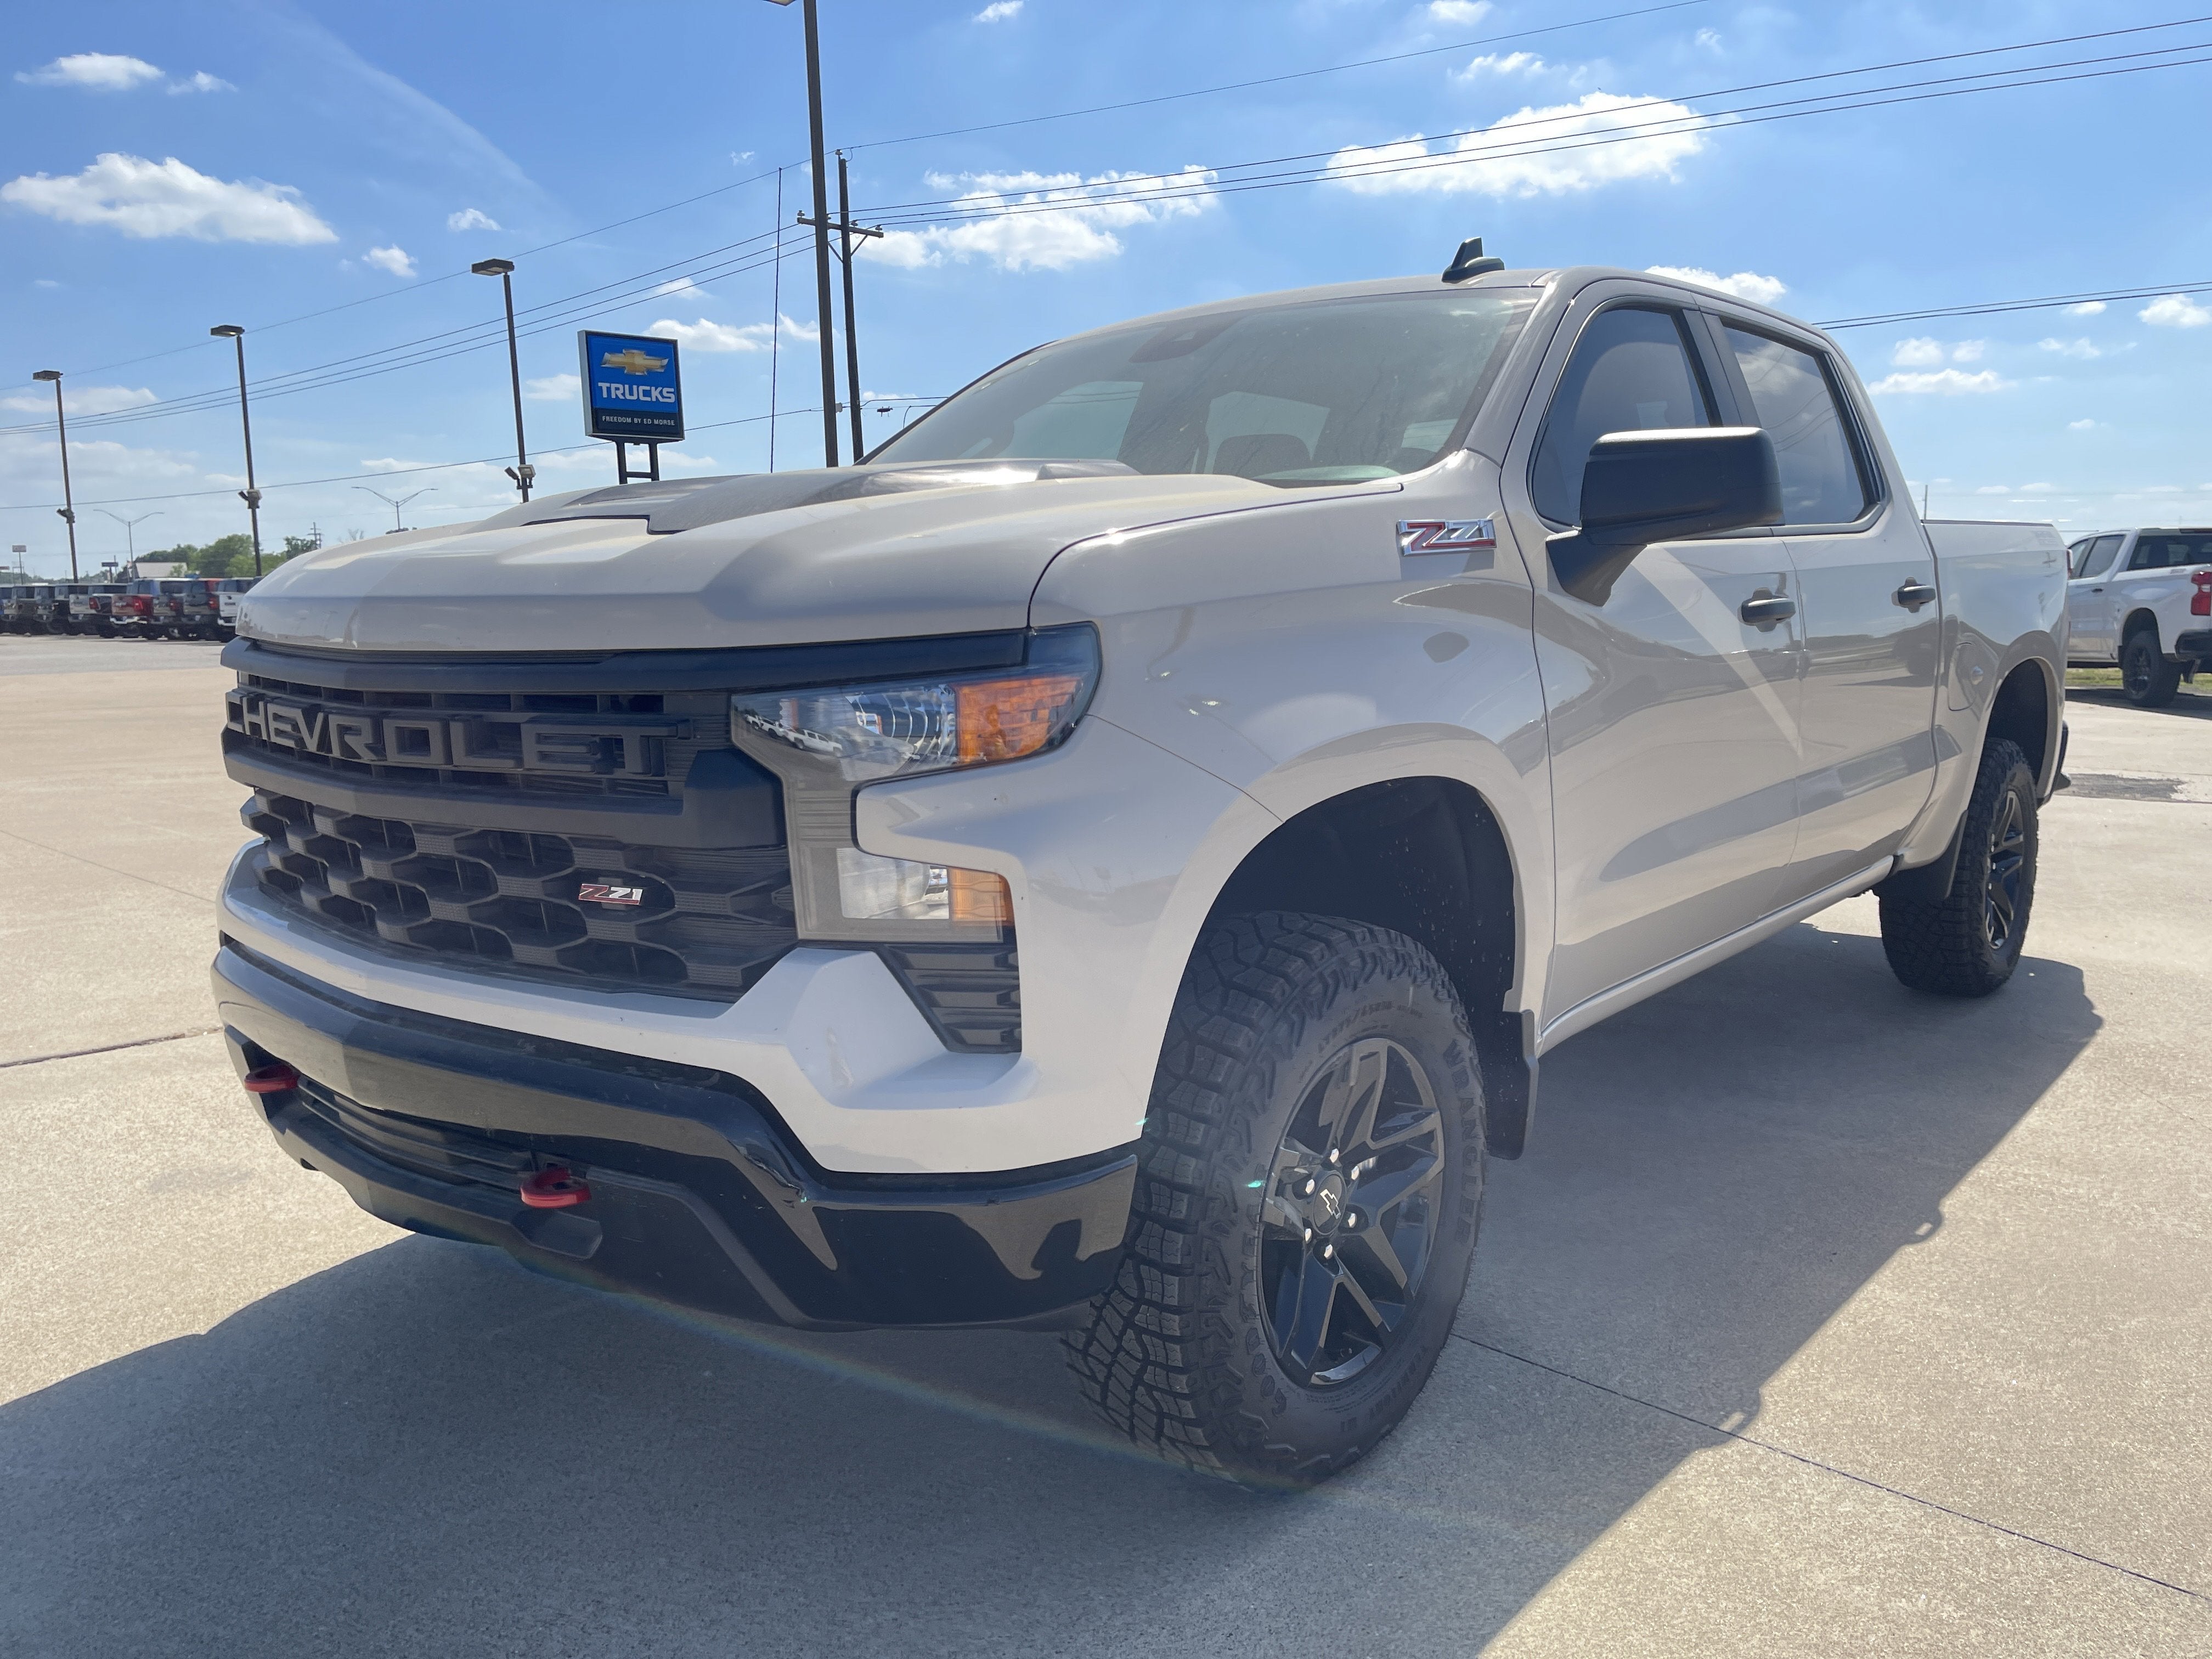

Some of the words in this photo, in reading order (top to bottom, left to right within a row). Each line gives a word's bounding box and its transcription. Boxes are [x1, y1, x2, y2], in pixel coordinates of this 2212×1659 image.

[598, 382, 675, 403] TRUCKS
[1397, 518, 1497, 556] Z71
[225, 689, 679, 775] CHEVROLET
[578, 883, 643, 905] Z71
[1443, 1039, 1478, 1245] WRANGLER
